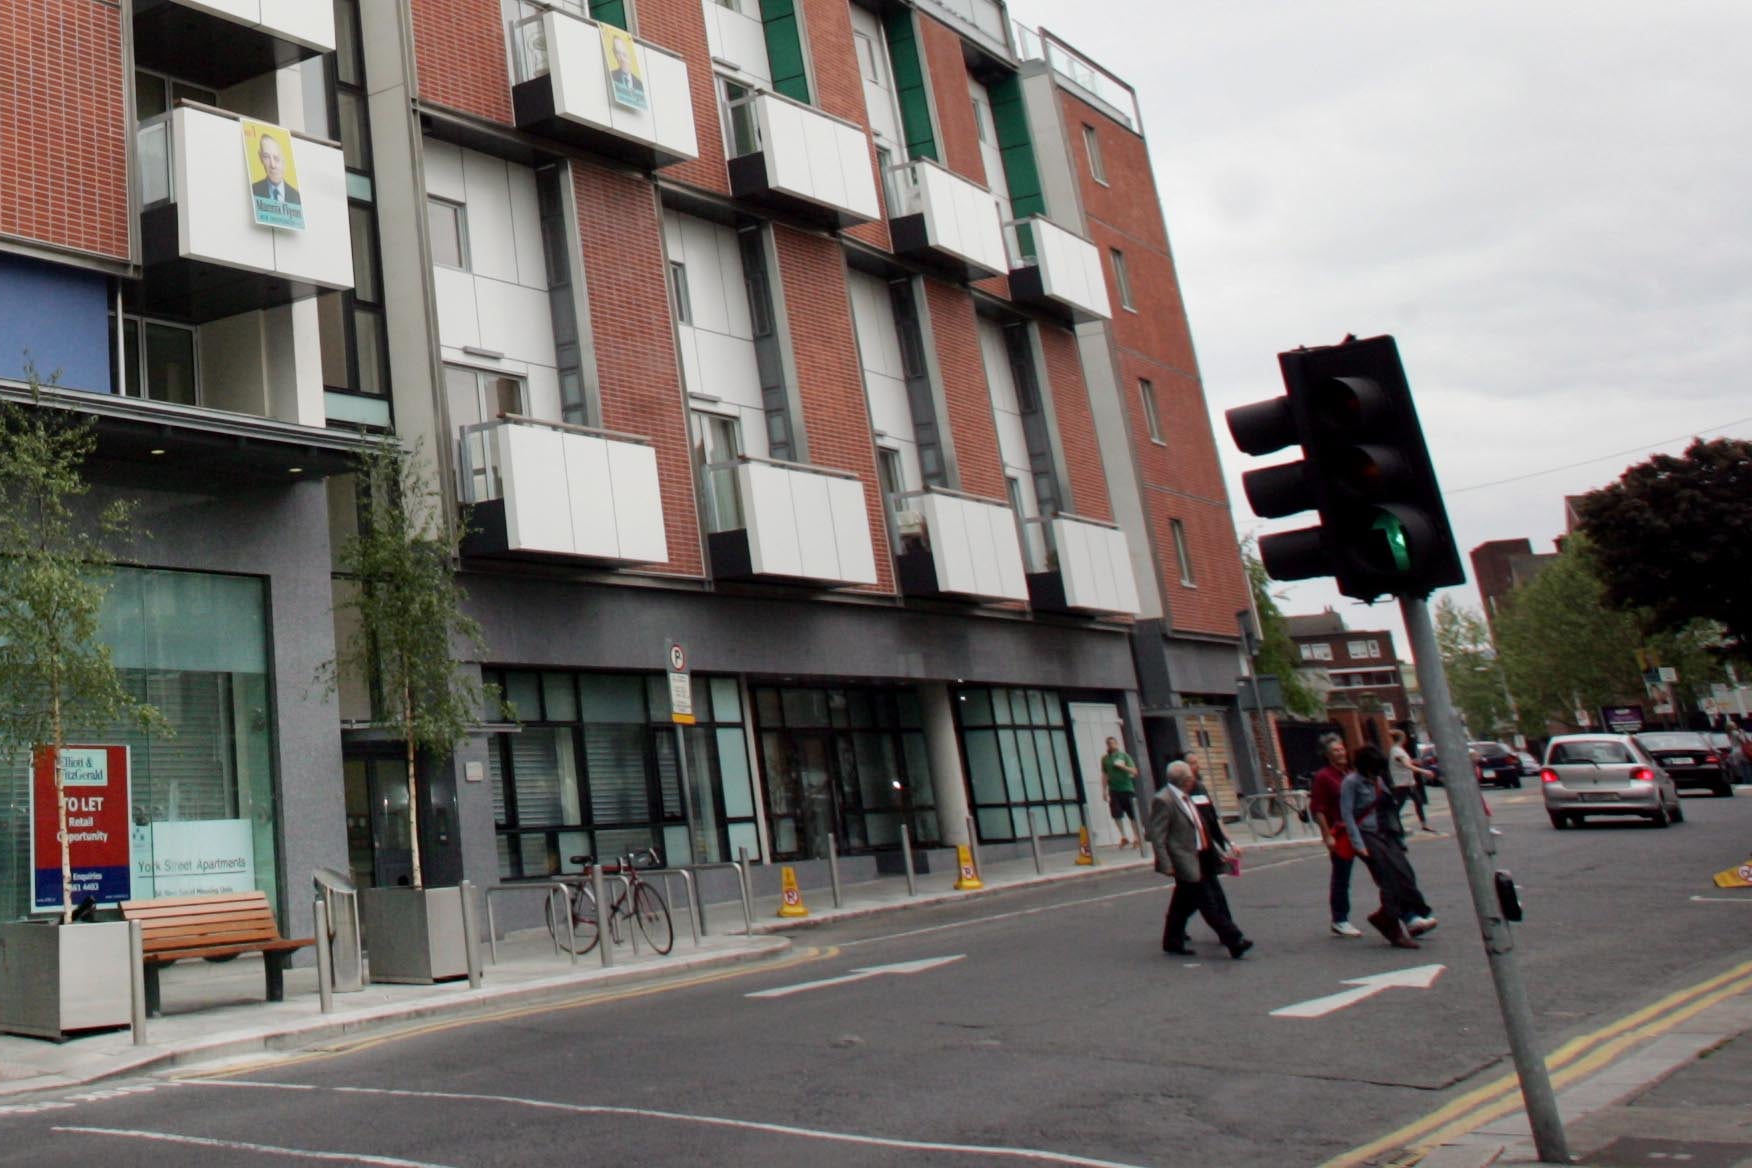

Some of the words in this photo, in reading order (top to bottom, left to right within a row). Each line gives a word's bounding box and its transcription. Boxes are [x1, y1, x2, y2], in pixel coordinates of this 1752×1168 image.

[81, 797, 104, 812] LET
[68, 816, 94, 827] Retail
[56, 830, 108, 843] Oportunity
[198, 857, 246, 873] Apartments
[72, 872, 103, 882] Enquiries
